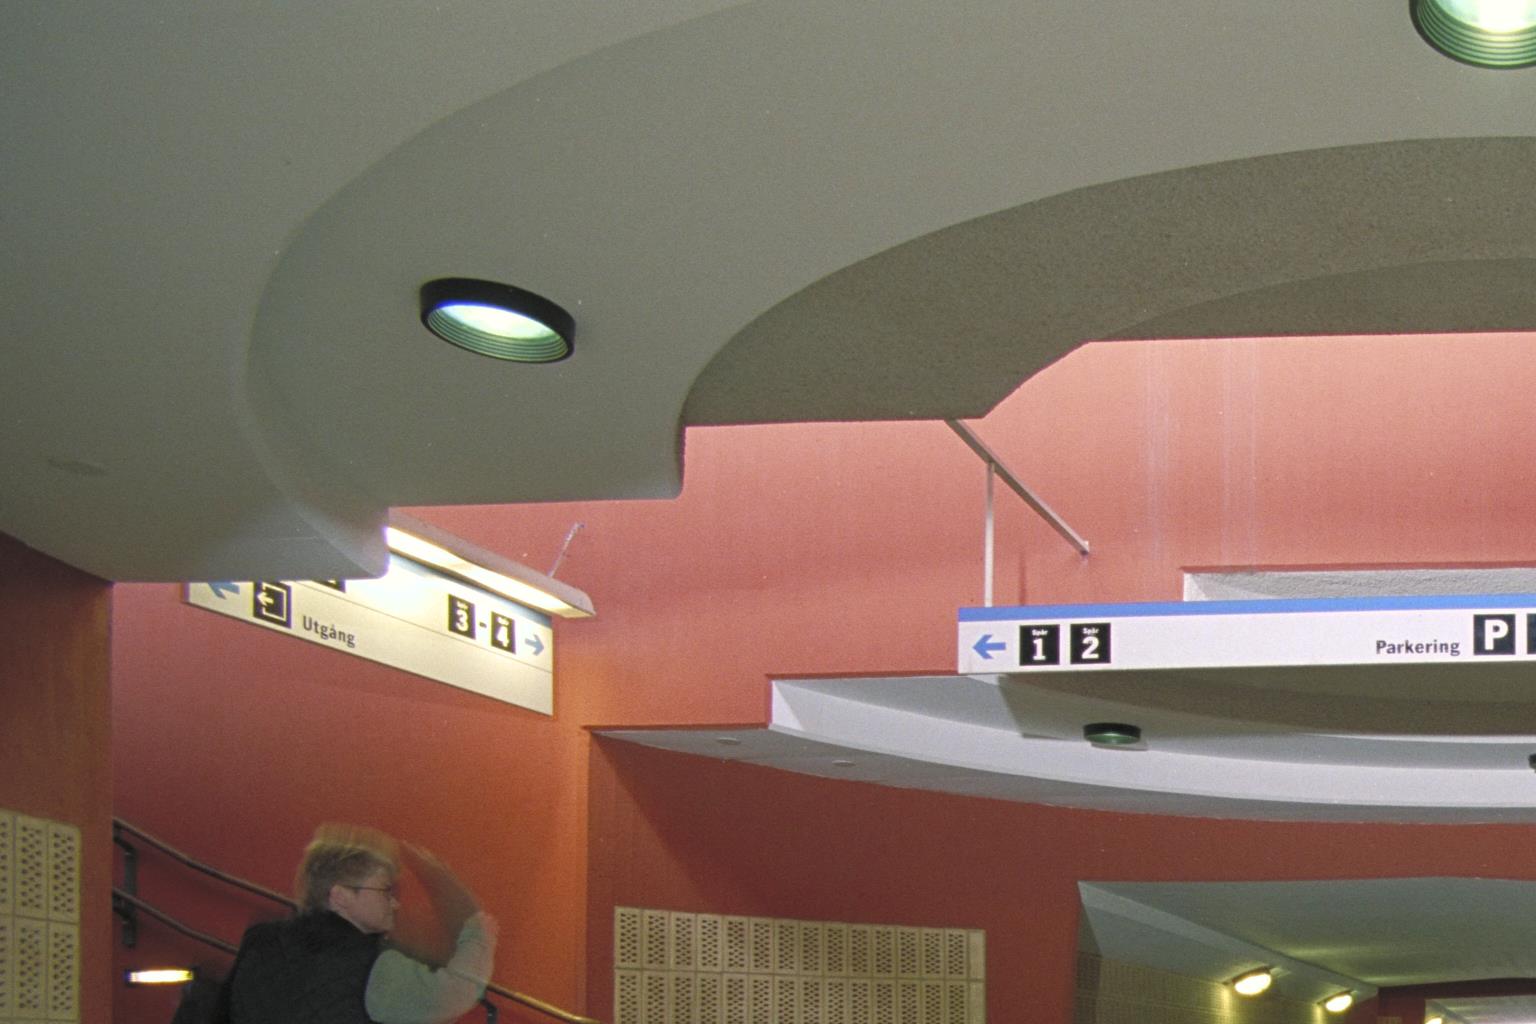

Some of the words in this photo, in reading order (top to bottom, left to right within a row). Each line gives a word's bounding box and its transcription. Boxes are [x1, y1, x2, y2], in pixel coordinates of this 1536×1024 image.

[303, 615, 356, 649] Utgång
[456, 609, 469, 632] 3
[497, 625, 509, 648] 4
[1375, 640, 1461, 657] Parkering
[1484, 619, 1509, 651] P
[1032, 638, 1046, 661] 1
[1081, 636, 1099, 660] 2
